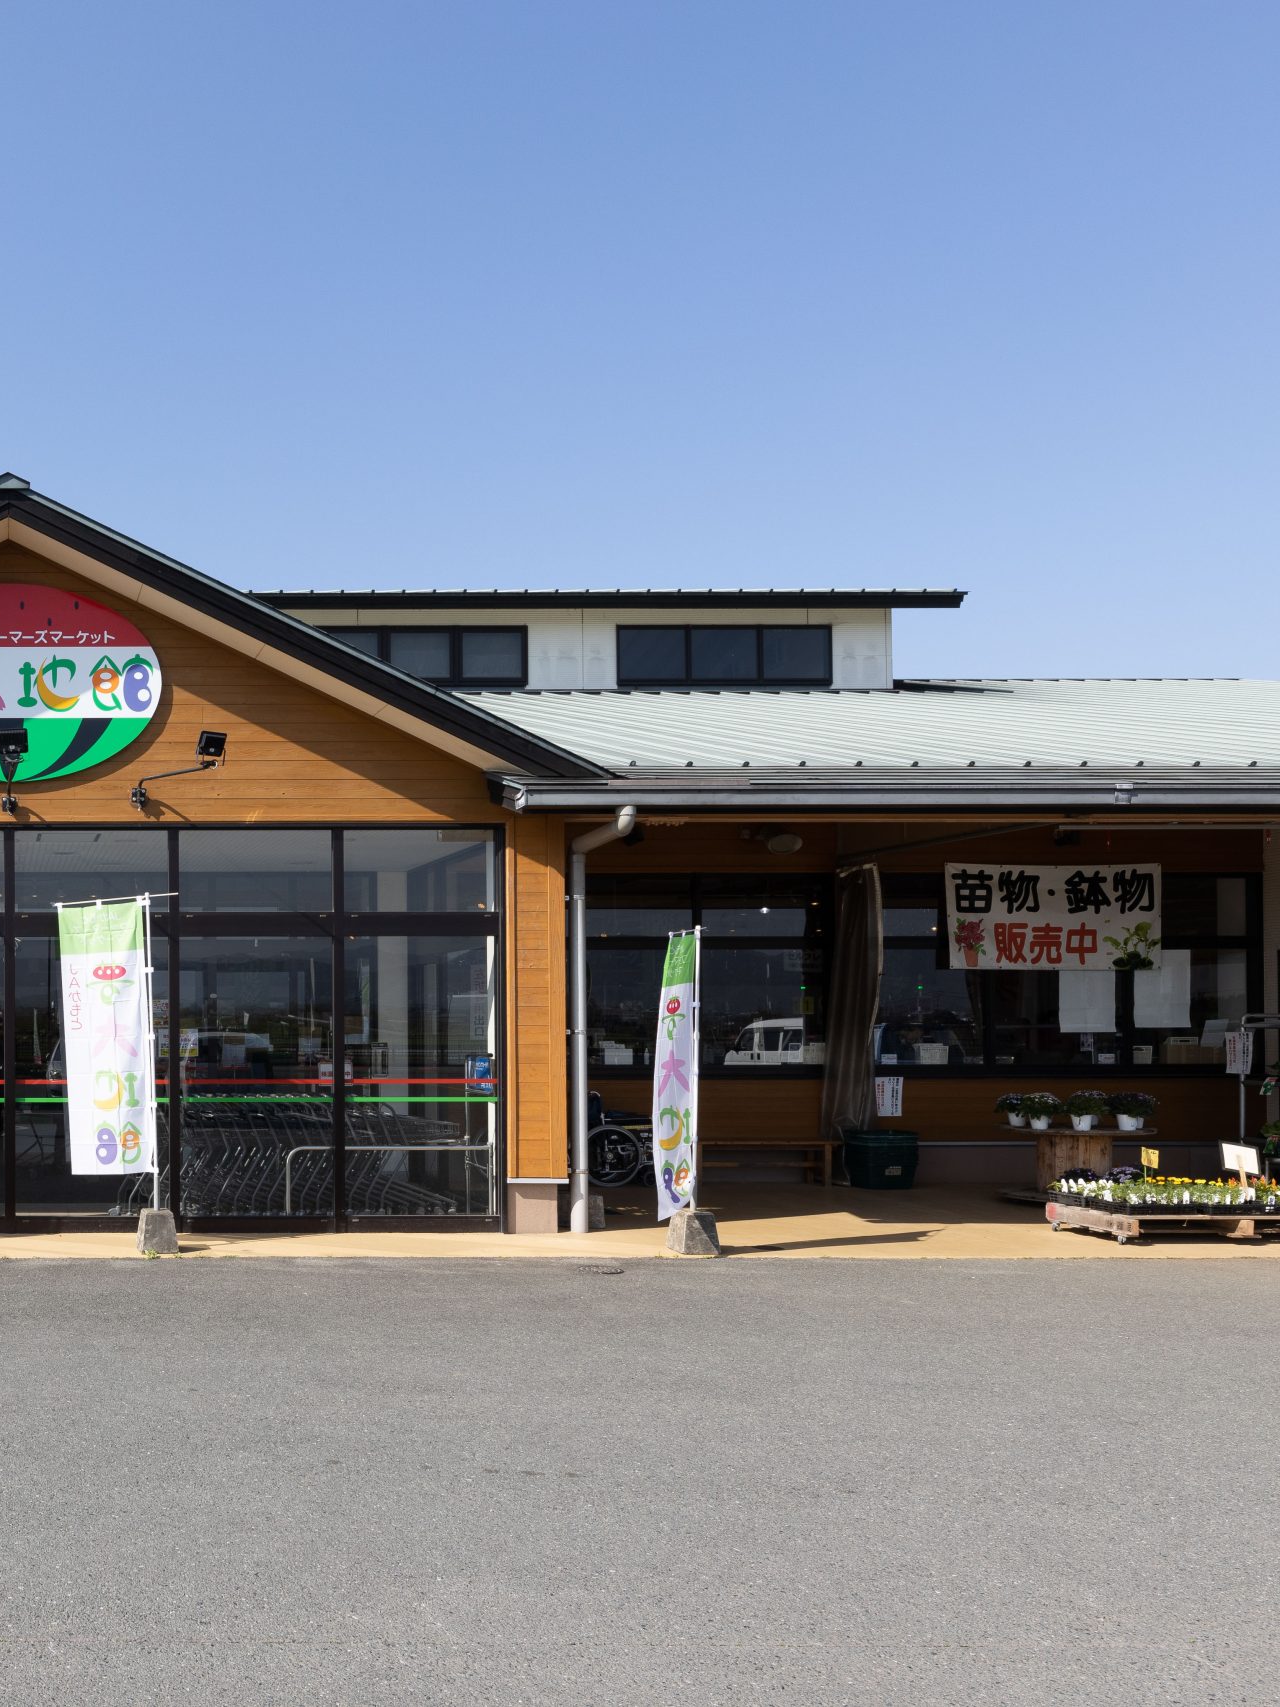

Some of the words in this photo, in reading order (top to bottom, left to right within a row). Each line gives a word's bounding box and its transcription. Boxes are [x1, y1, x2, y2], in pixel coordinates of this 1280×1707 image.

[951, 868, 1155, 915] 苗物・鉢物
[993, 921, 1098, 965] 販売中
